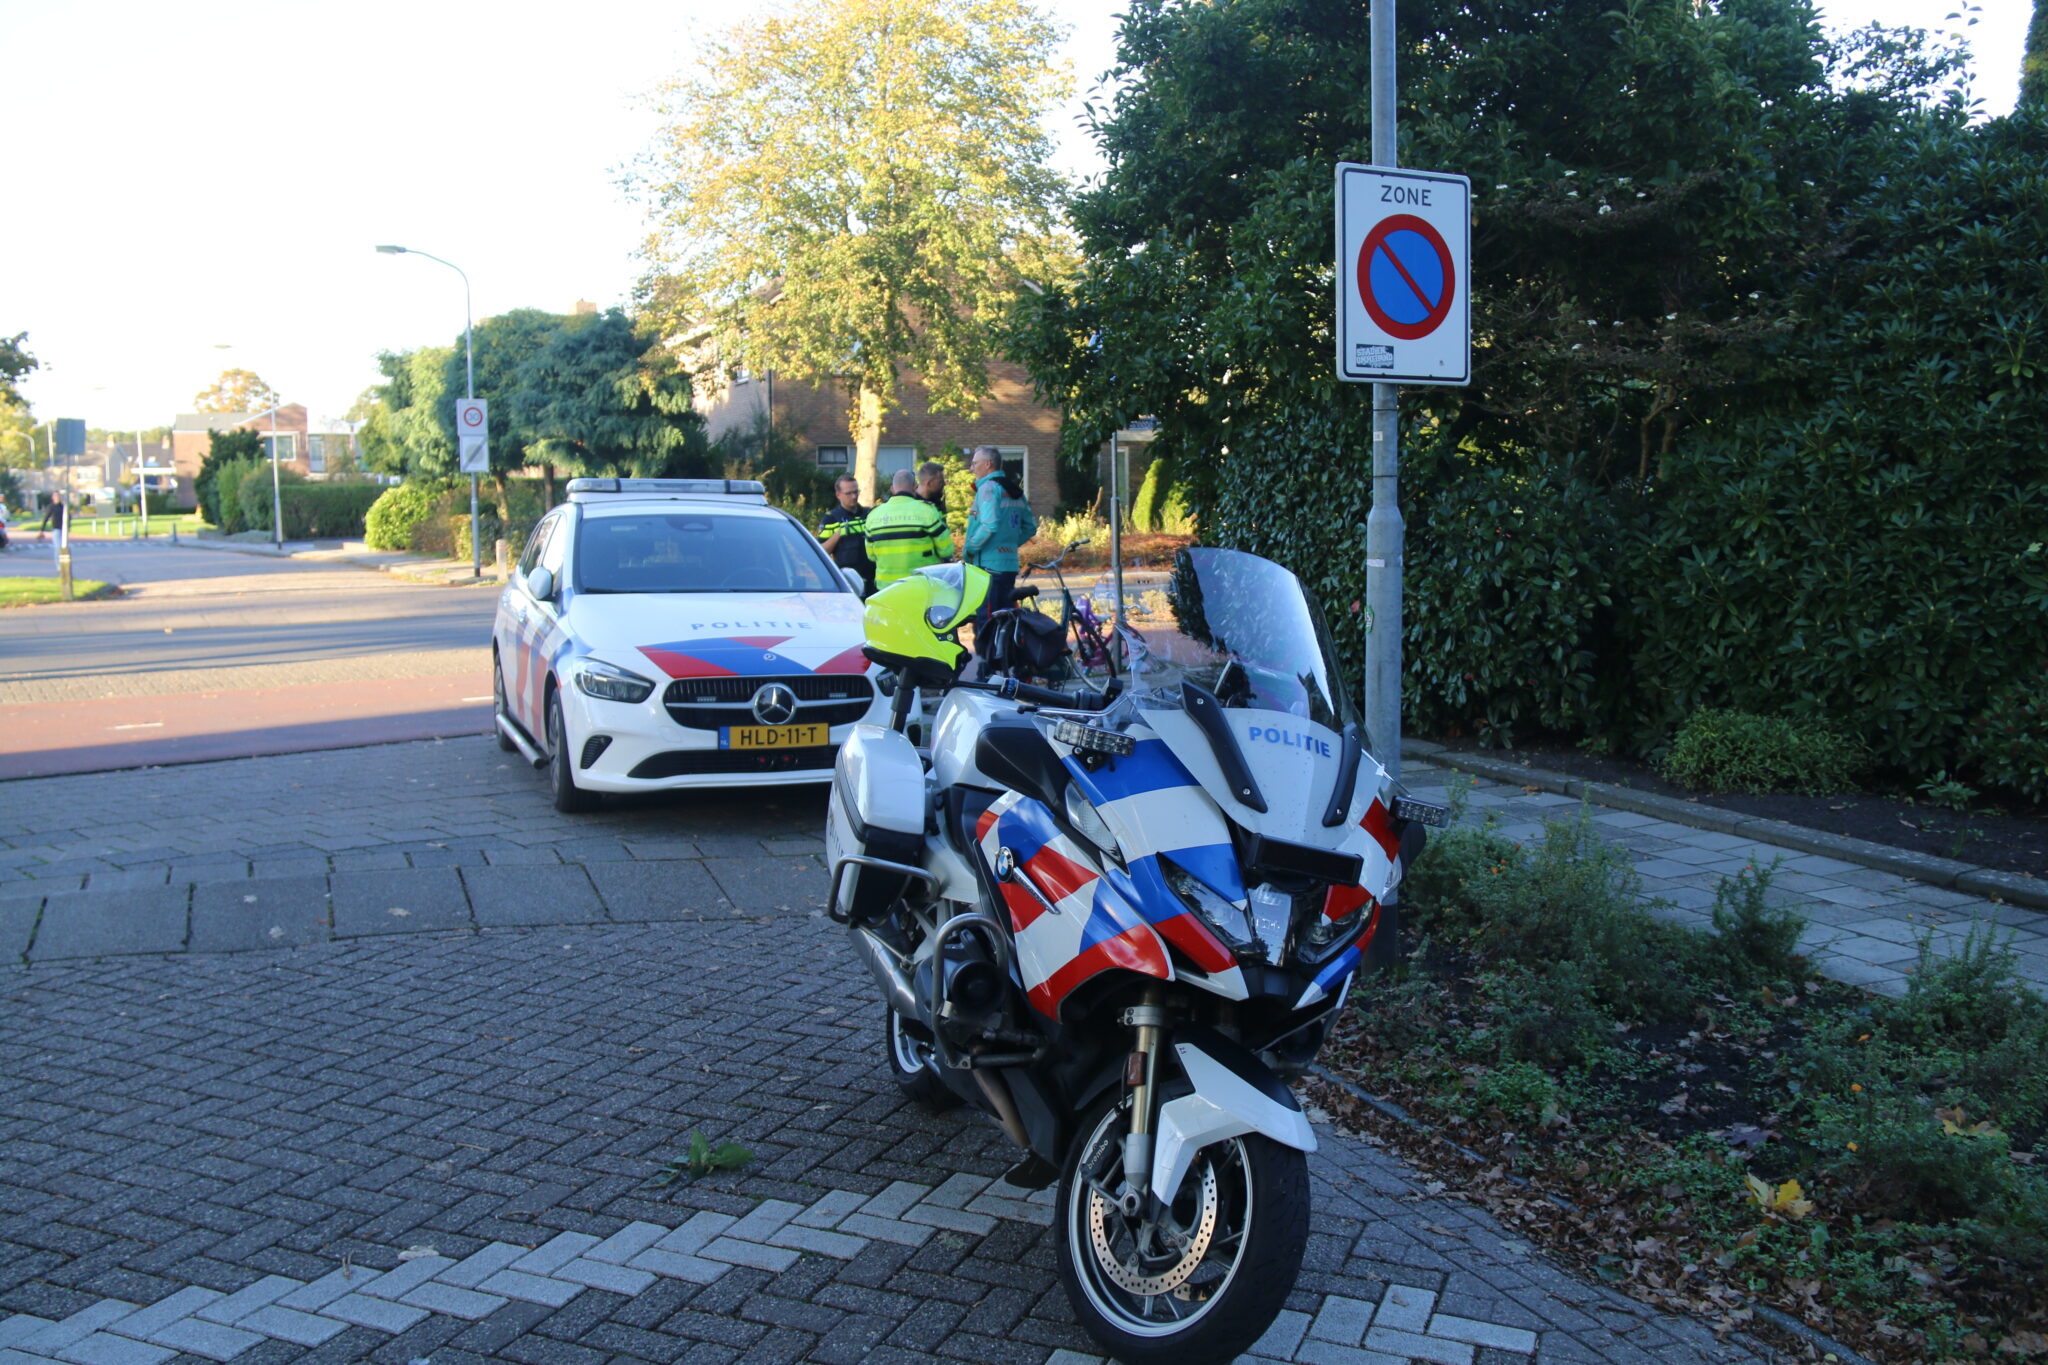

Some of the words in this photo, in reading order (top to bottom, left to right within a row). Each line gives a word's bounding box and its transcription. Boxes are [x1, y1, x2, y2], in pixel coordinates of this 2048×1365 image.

[1381, 185, 1432, 206] ZONE
[690, 621, 813, 630] POLITIE
[740, 727, 817, 746] HLD-11-T
[1248, 726, 1331, 758] POLITIE
[1087, 1139, 1109, 1170] brembo
